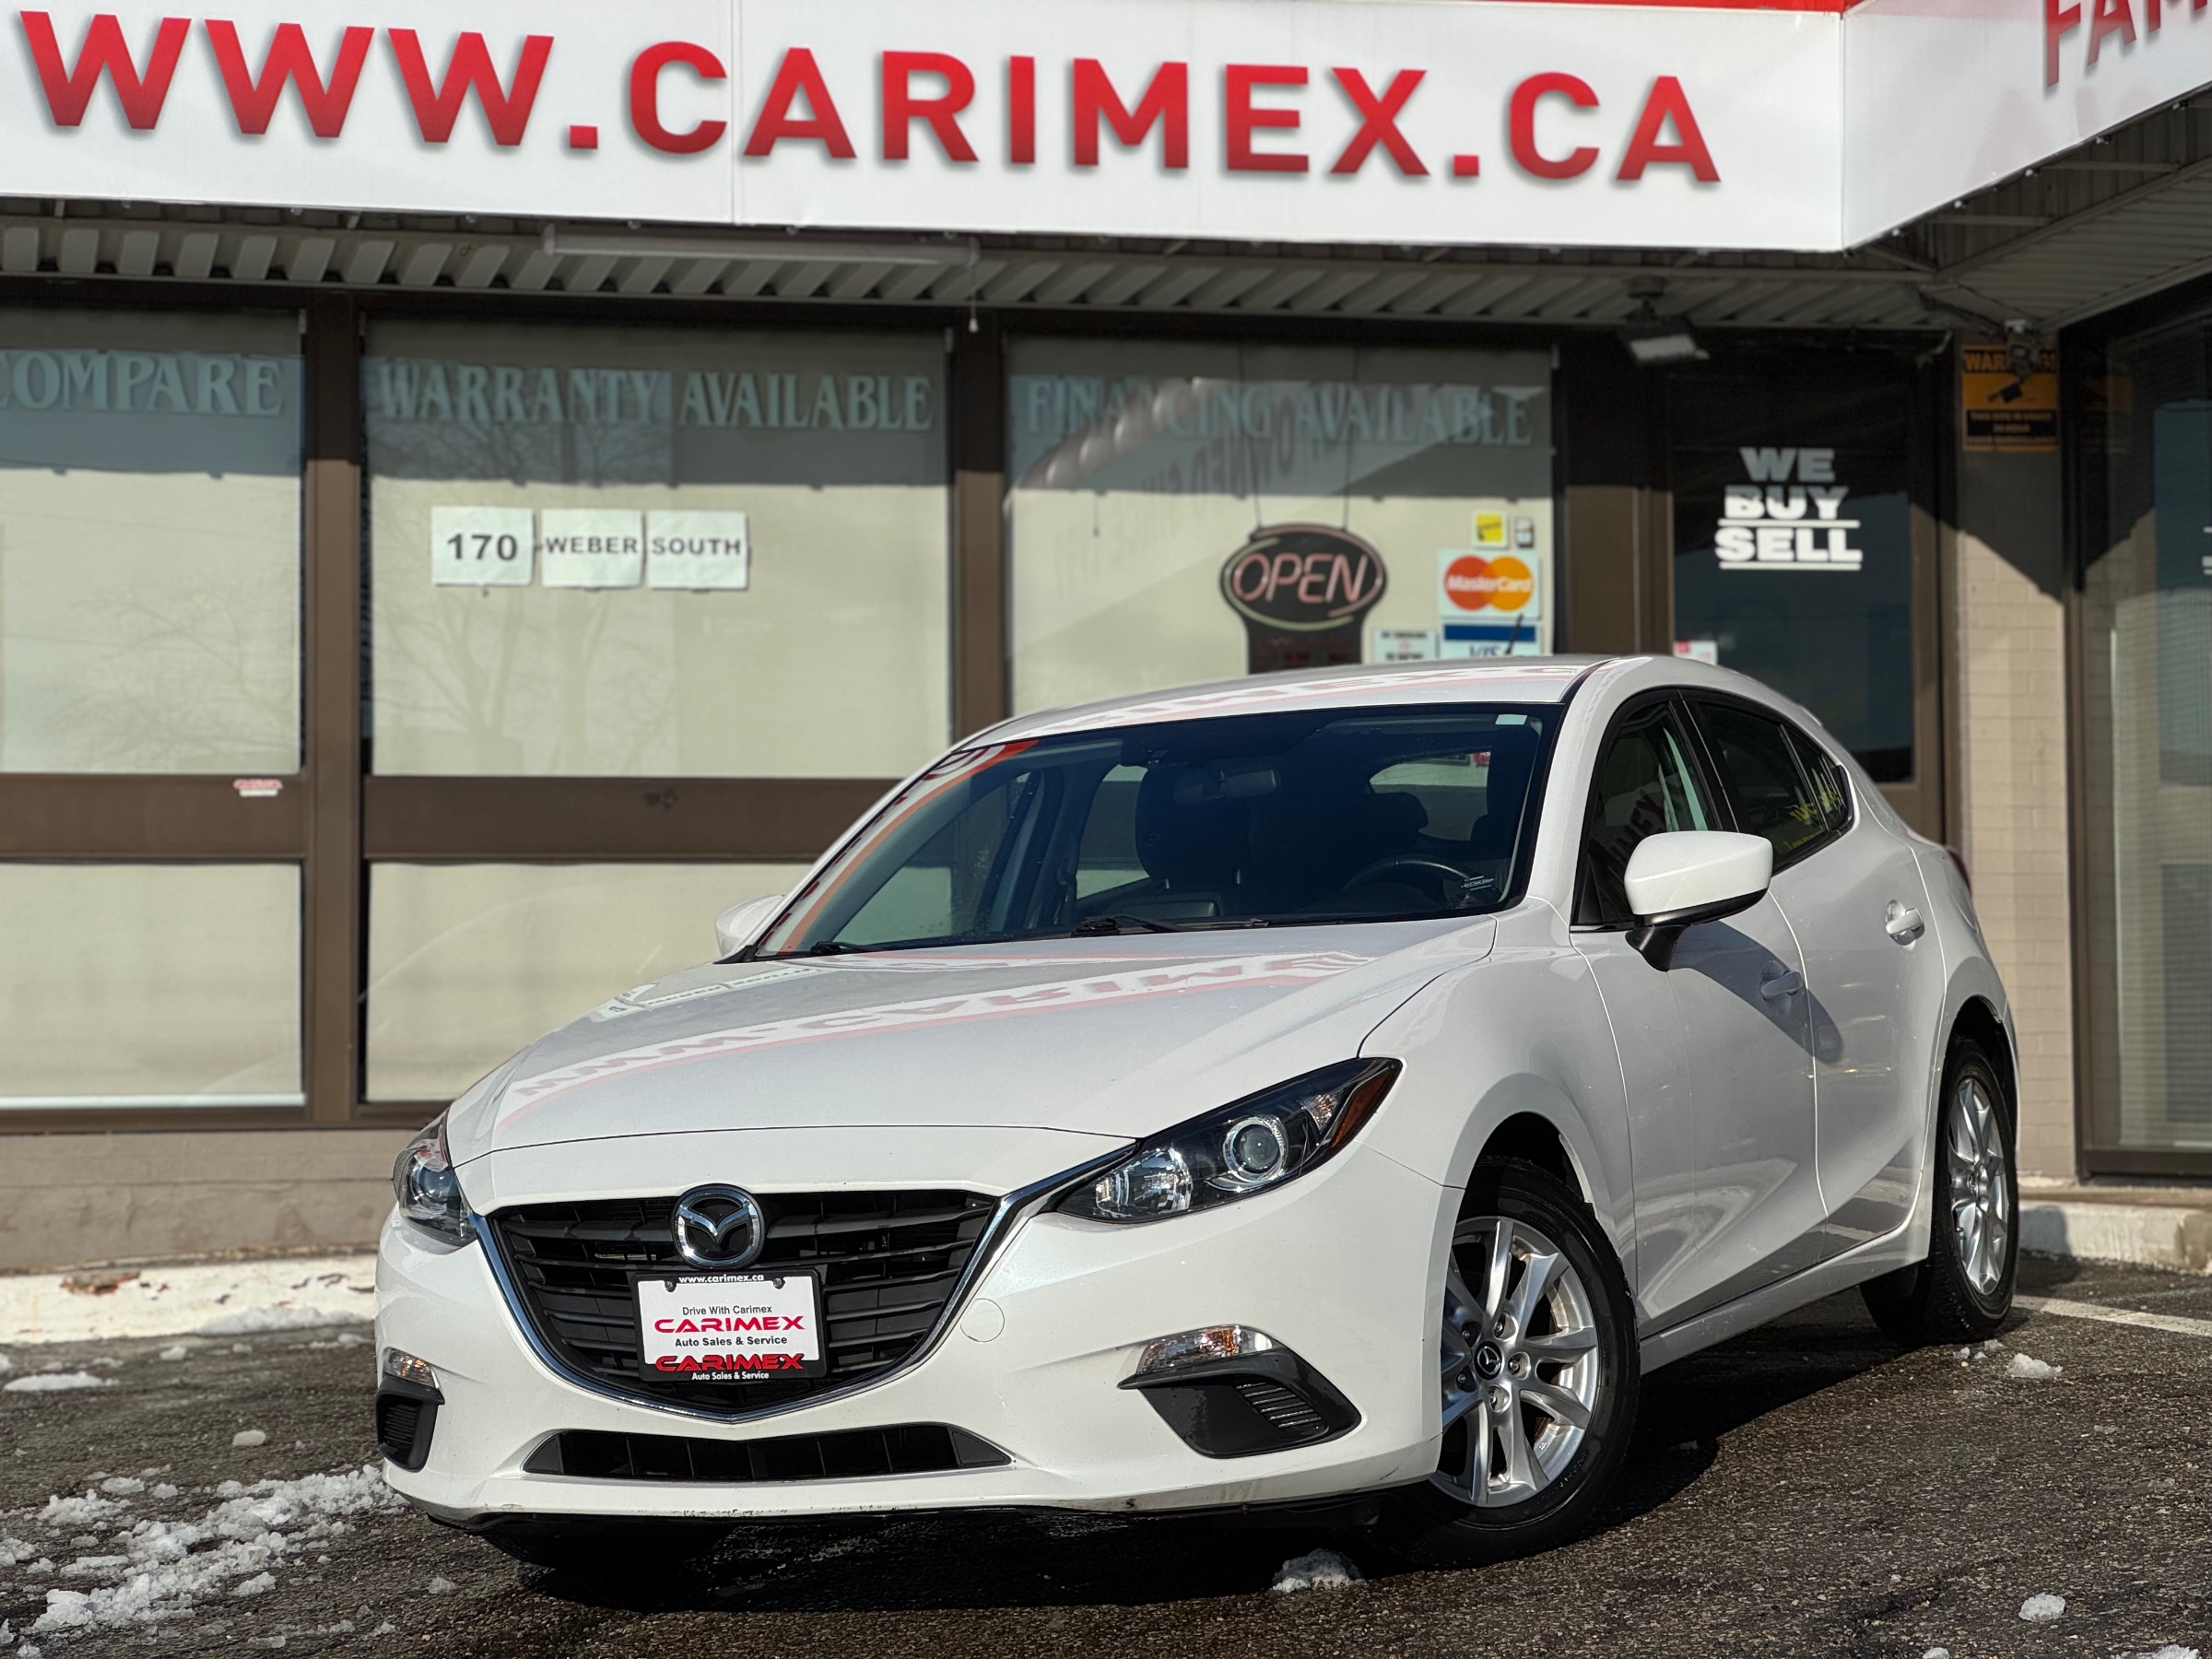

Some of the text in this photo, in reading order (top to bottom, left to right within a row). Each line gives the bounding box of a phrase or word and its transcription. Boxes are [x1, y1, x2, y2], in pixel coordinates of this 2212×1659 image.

[2046, 0, 2208, 88] FA
[20, 11, 1720, 183] WWW.CARIMEX.CA
[375, 358, 934, 431] WARRANTY AVAILABLE
[1295, 382, 1532, 444] AVAILABLE
[1740, 447, 1836, 482] WE
[1724, 485, 1848, 521] BUY
[446, 534, 742, 561] 170 WEBER SOUTH
[1715, 526, 1863, 563] SELL
[1232, 554, 1368, 604] OPEN
[678, 1274, 765, 1284] www.carimex.ca
[653, 1315, 806, 1334] CARIMEX
[682, 1305, 772, 1316] Drive With Carimex
[675, 1335, 788, 1347] Auto Sales & Service
[653, 1353, 805, 1372] CARIMEX
[691, 1371, 770, 1381] Auto Sales & Service
